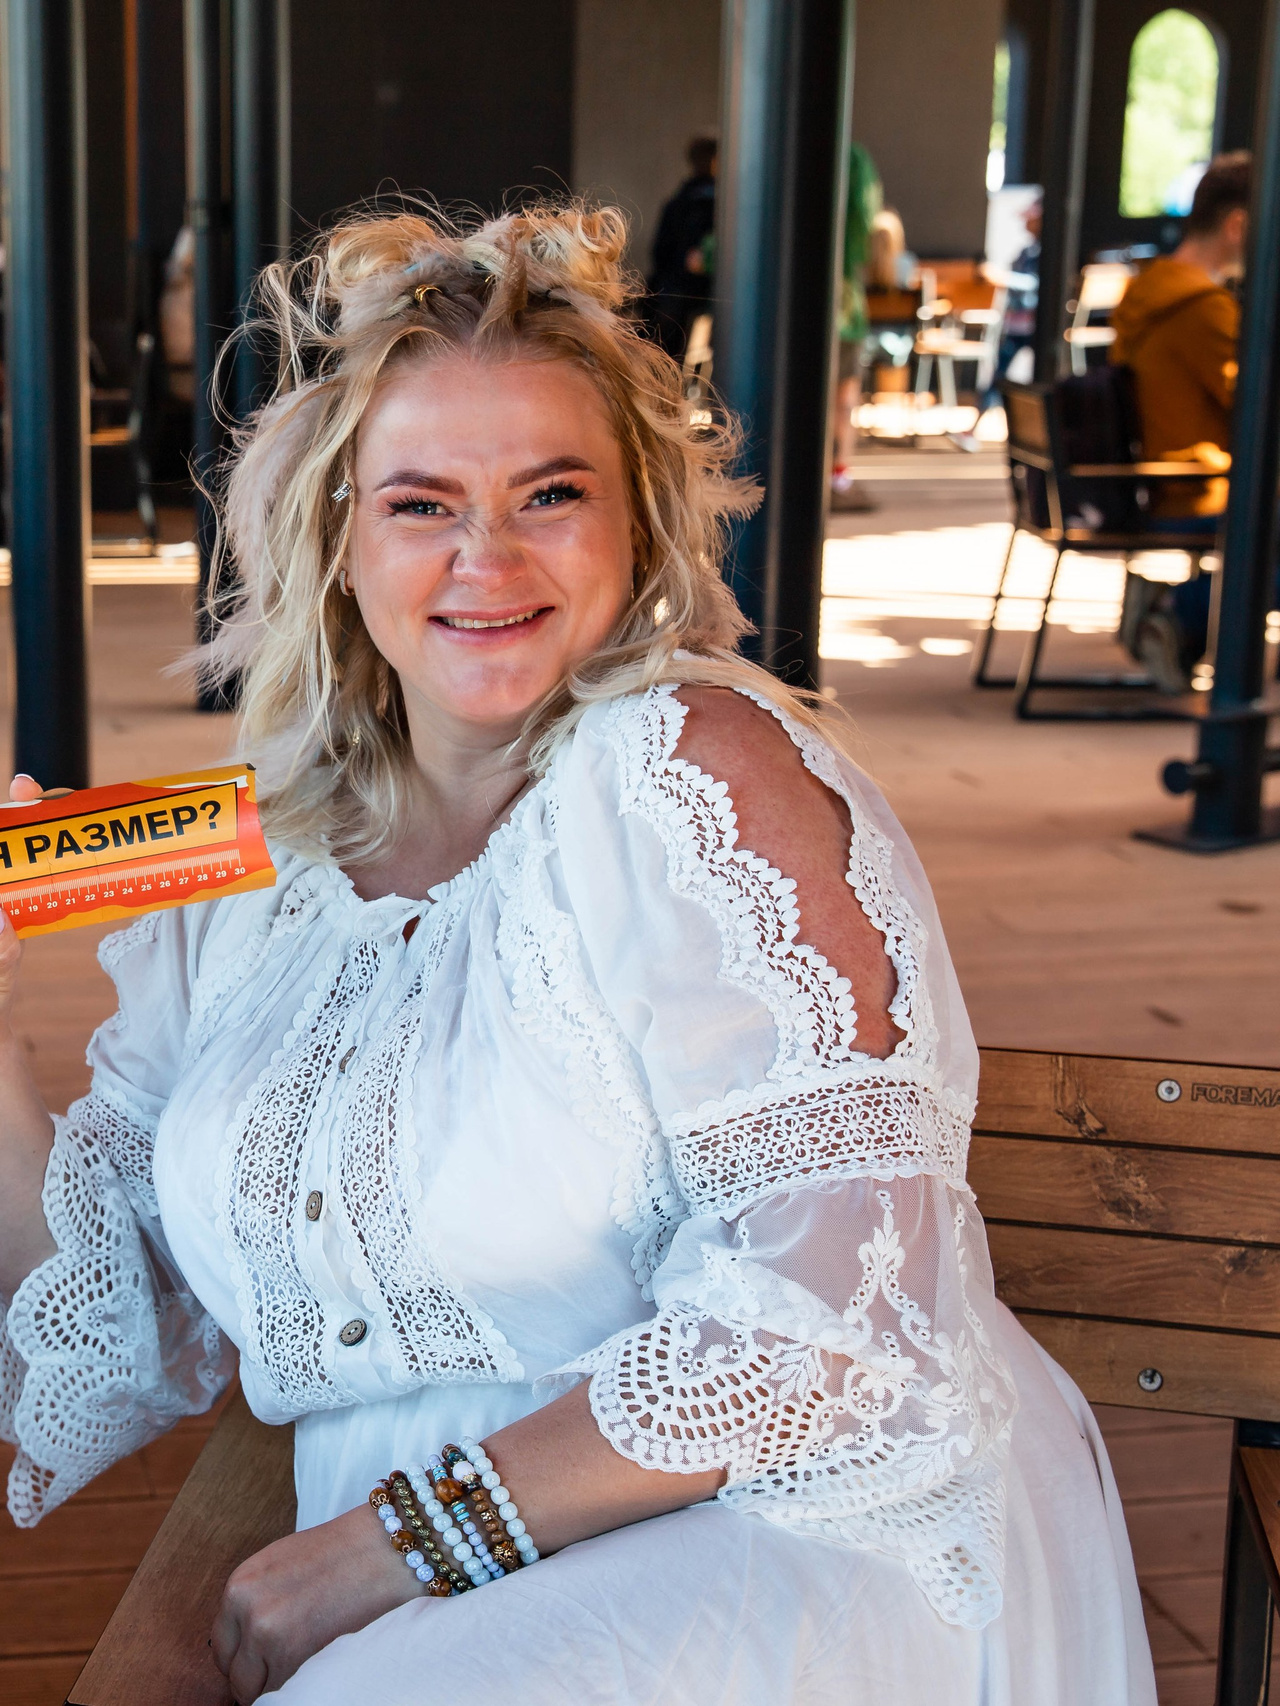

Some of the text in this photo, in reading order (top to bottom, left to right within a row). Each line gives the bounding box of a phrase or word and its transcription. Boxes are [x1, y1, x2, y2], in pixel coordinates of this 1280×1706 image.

[24, 800, 222, 864] РАЗМЕР?
[9, 908, 21, 916] 18
[27, 904, 39, 913] 19
[46, 900, 58, 909] 20
[65, 897, 77, 905] 21
[84, 893, 96, 902] 22
[103, 889, 115, 898] 23
[122, 886, 134, 895] 24
[140, 883, 153, 892] 25
[159, 880, 172, 889] 26
[178, 876, 190, 885] 27
[197, 873, 209, 882] 28
[215, 870, 228, 879] 29
[234, 866, 247, 875] 30
